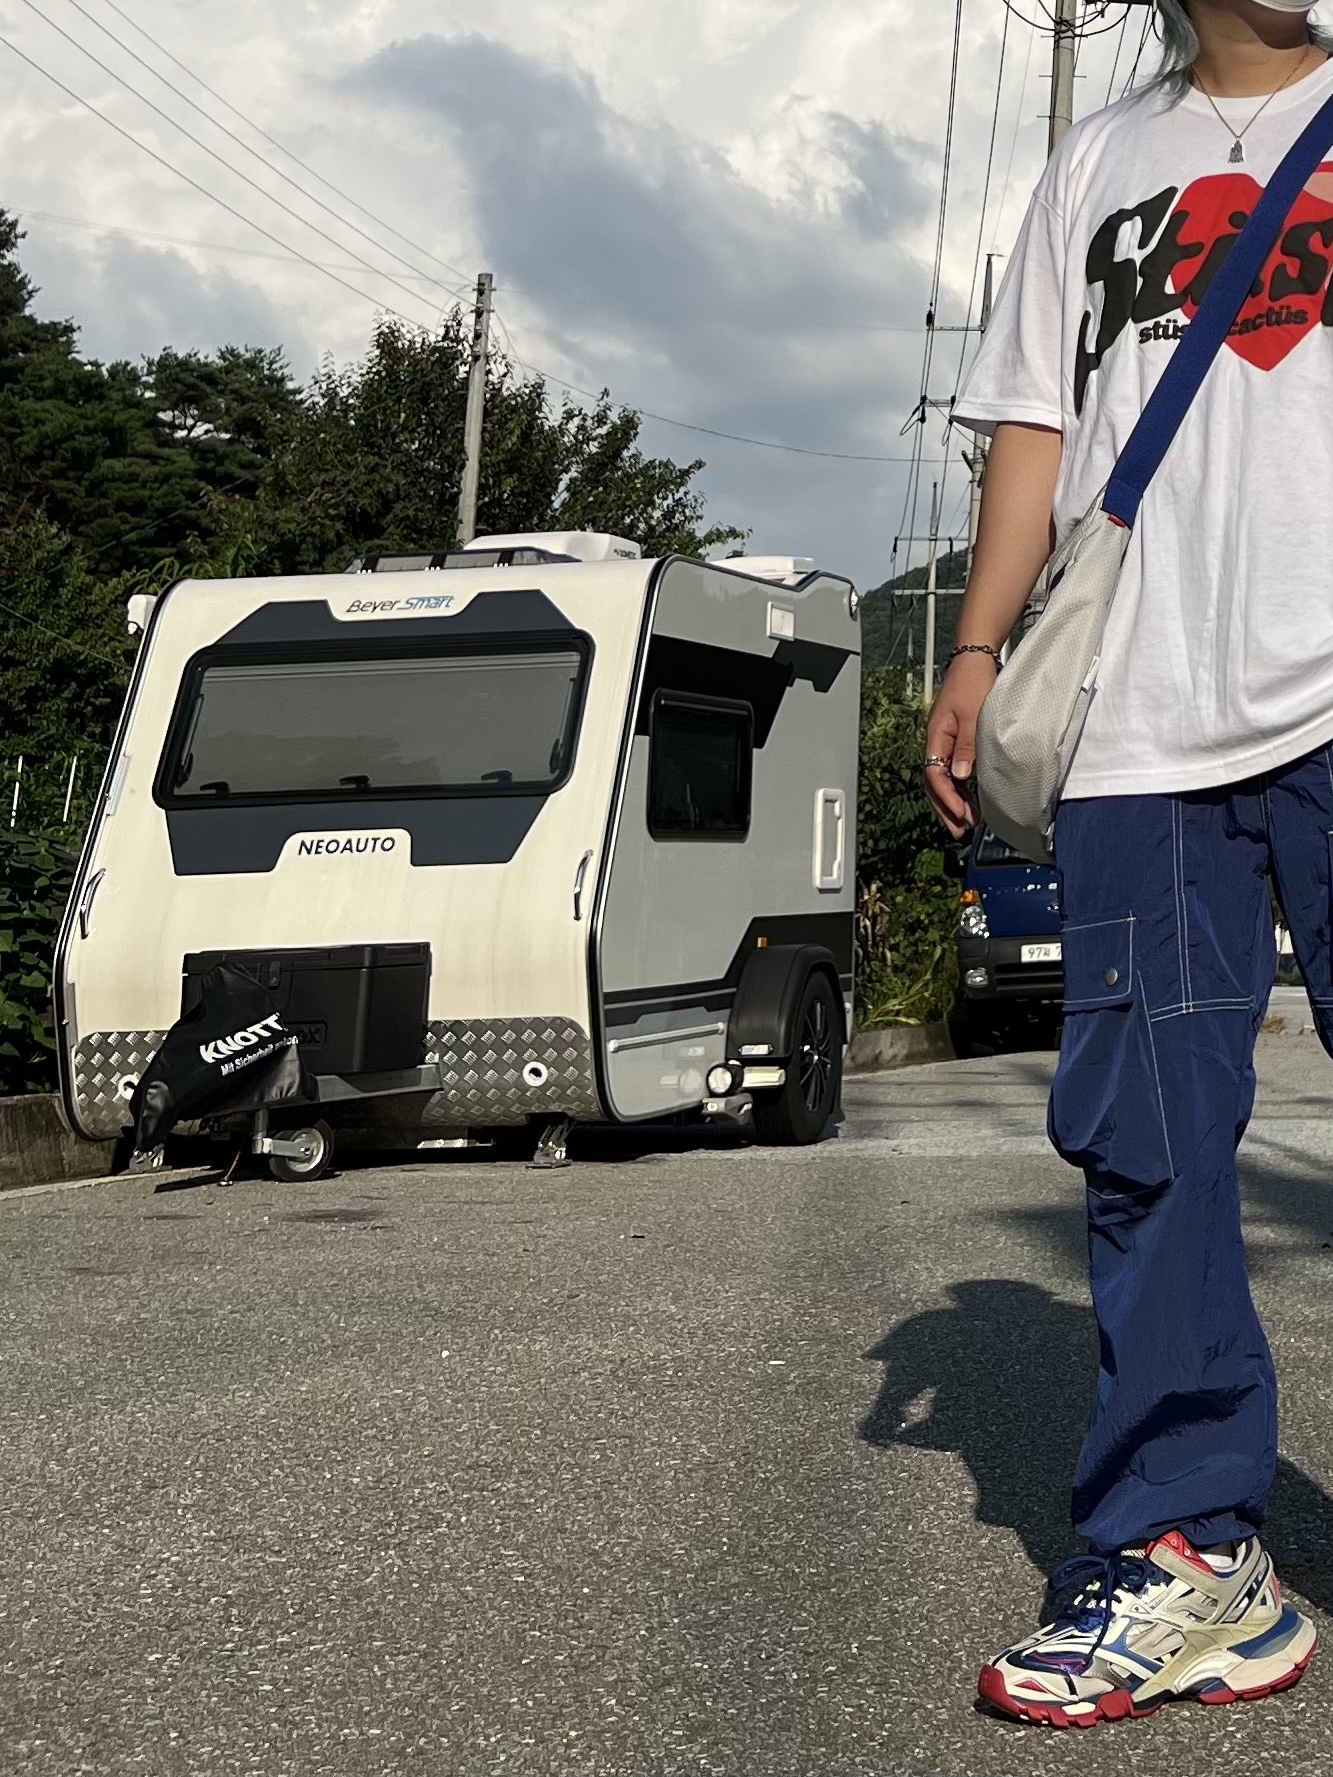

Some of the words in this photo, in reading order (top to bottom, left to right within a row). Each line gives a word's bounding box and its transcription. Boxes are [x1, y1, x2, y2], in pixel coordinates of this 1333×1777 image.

[345, 599, 401, 613] Beyer
[397, 595, 455, 610] Smart
[298, 836, 396, 856] NEOAUTO
[199, 1012, 284, 1064] KNOTT
